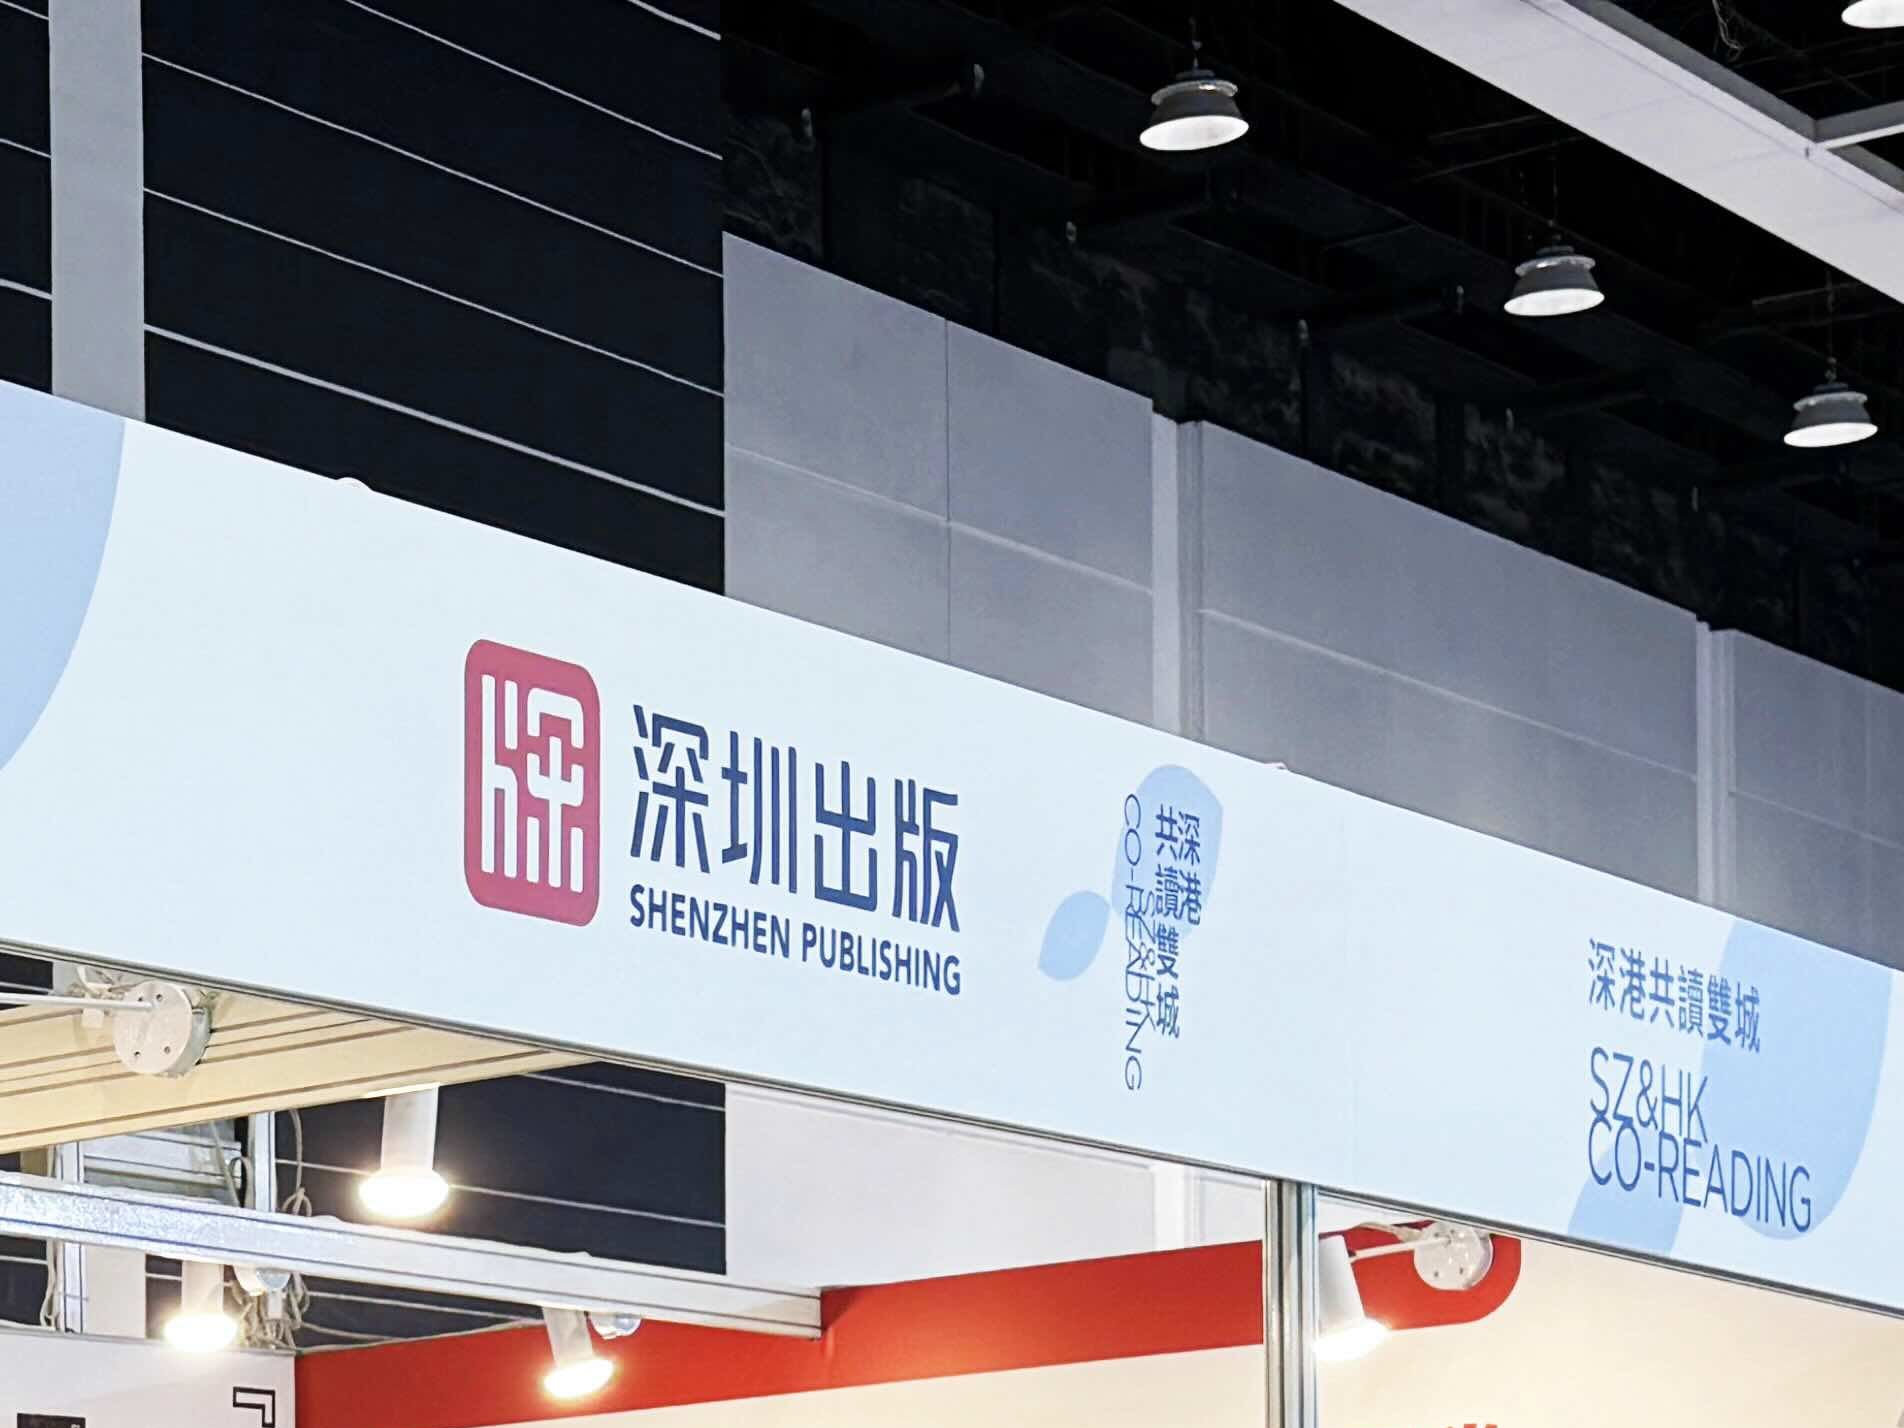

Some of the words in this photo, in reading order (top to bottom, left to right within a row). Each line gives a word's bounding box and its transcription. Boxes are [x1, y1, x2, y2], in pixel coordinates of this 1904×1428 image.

[630, 705, 960, 935] 深圳出版
[1179, 811, 1201, 925] 深港
[630, 886, 791, 959] SHENZHEN
[801, 919, 961, 996] PUBLISHING
[1125, 794, 1142, 1090] CO-READING
[1155, 804, 1179, 1038] 共讀雙城
[1589, 938, 1761, 1055] 深港共讀雙城
[1589, 1049, 1708, 1146] SZ&HK
[1588, 1119, 1811, 1235] CO-READING
